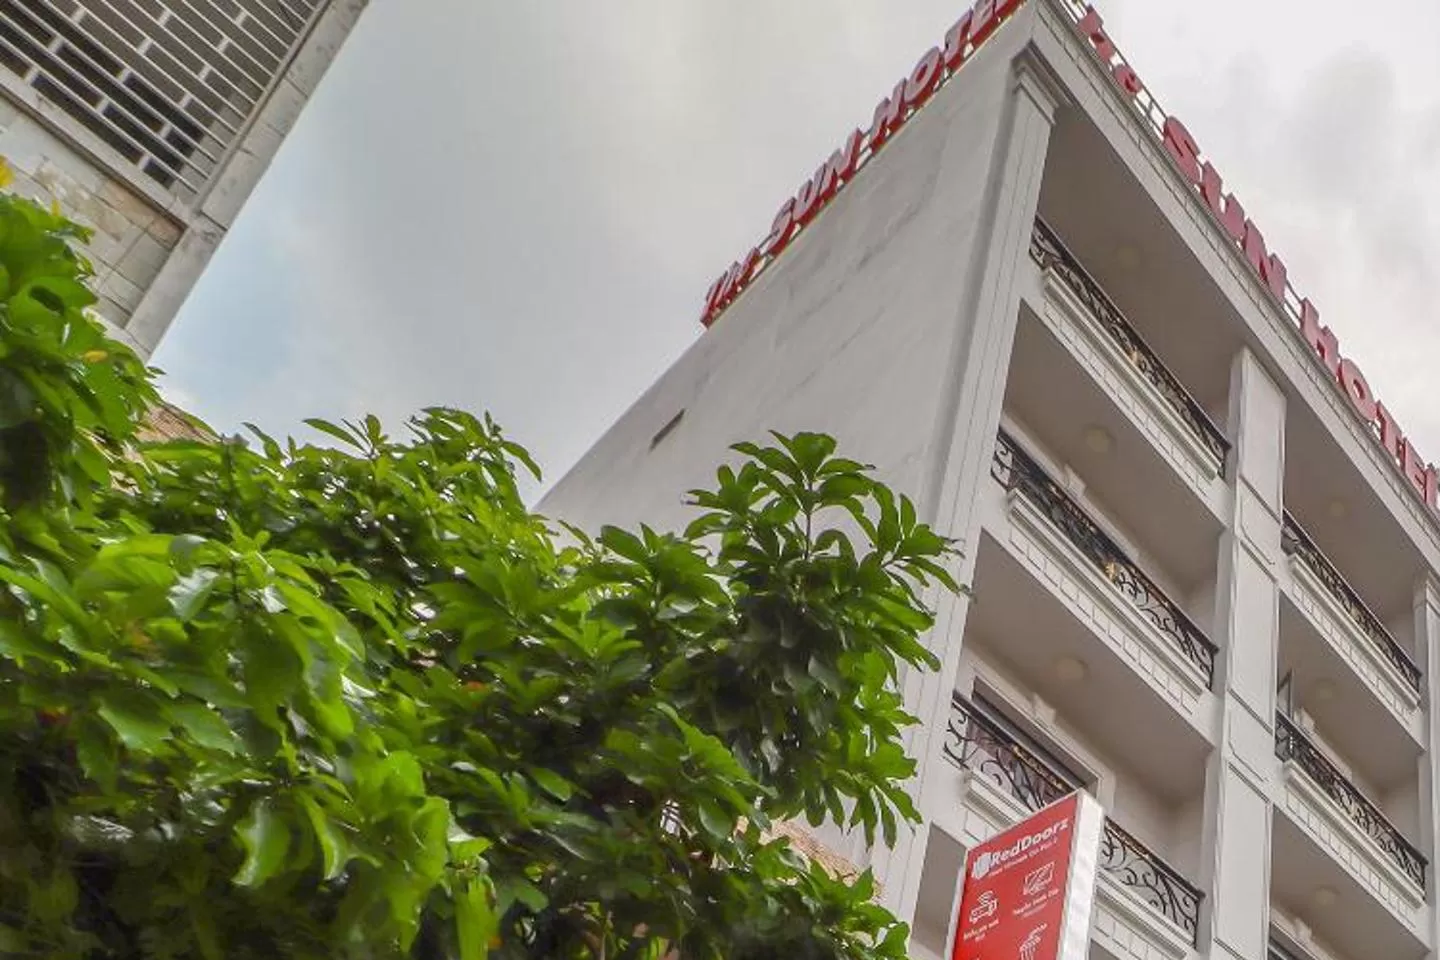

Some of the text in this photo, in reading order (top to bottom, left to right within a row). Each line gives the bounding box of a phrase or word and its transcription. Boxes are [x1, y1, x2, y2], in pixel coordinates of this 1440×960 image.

[767, 127, 863, 258] SUN
[1163, 115, 1287, 306] SUN
[1300, 297, 1440, 504] HOTEL
[990, 817, 1069, 868] RedDoorz
